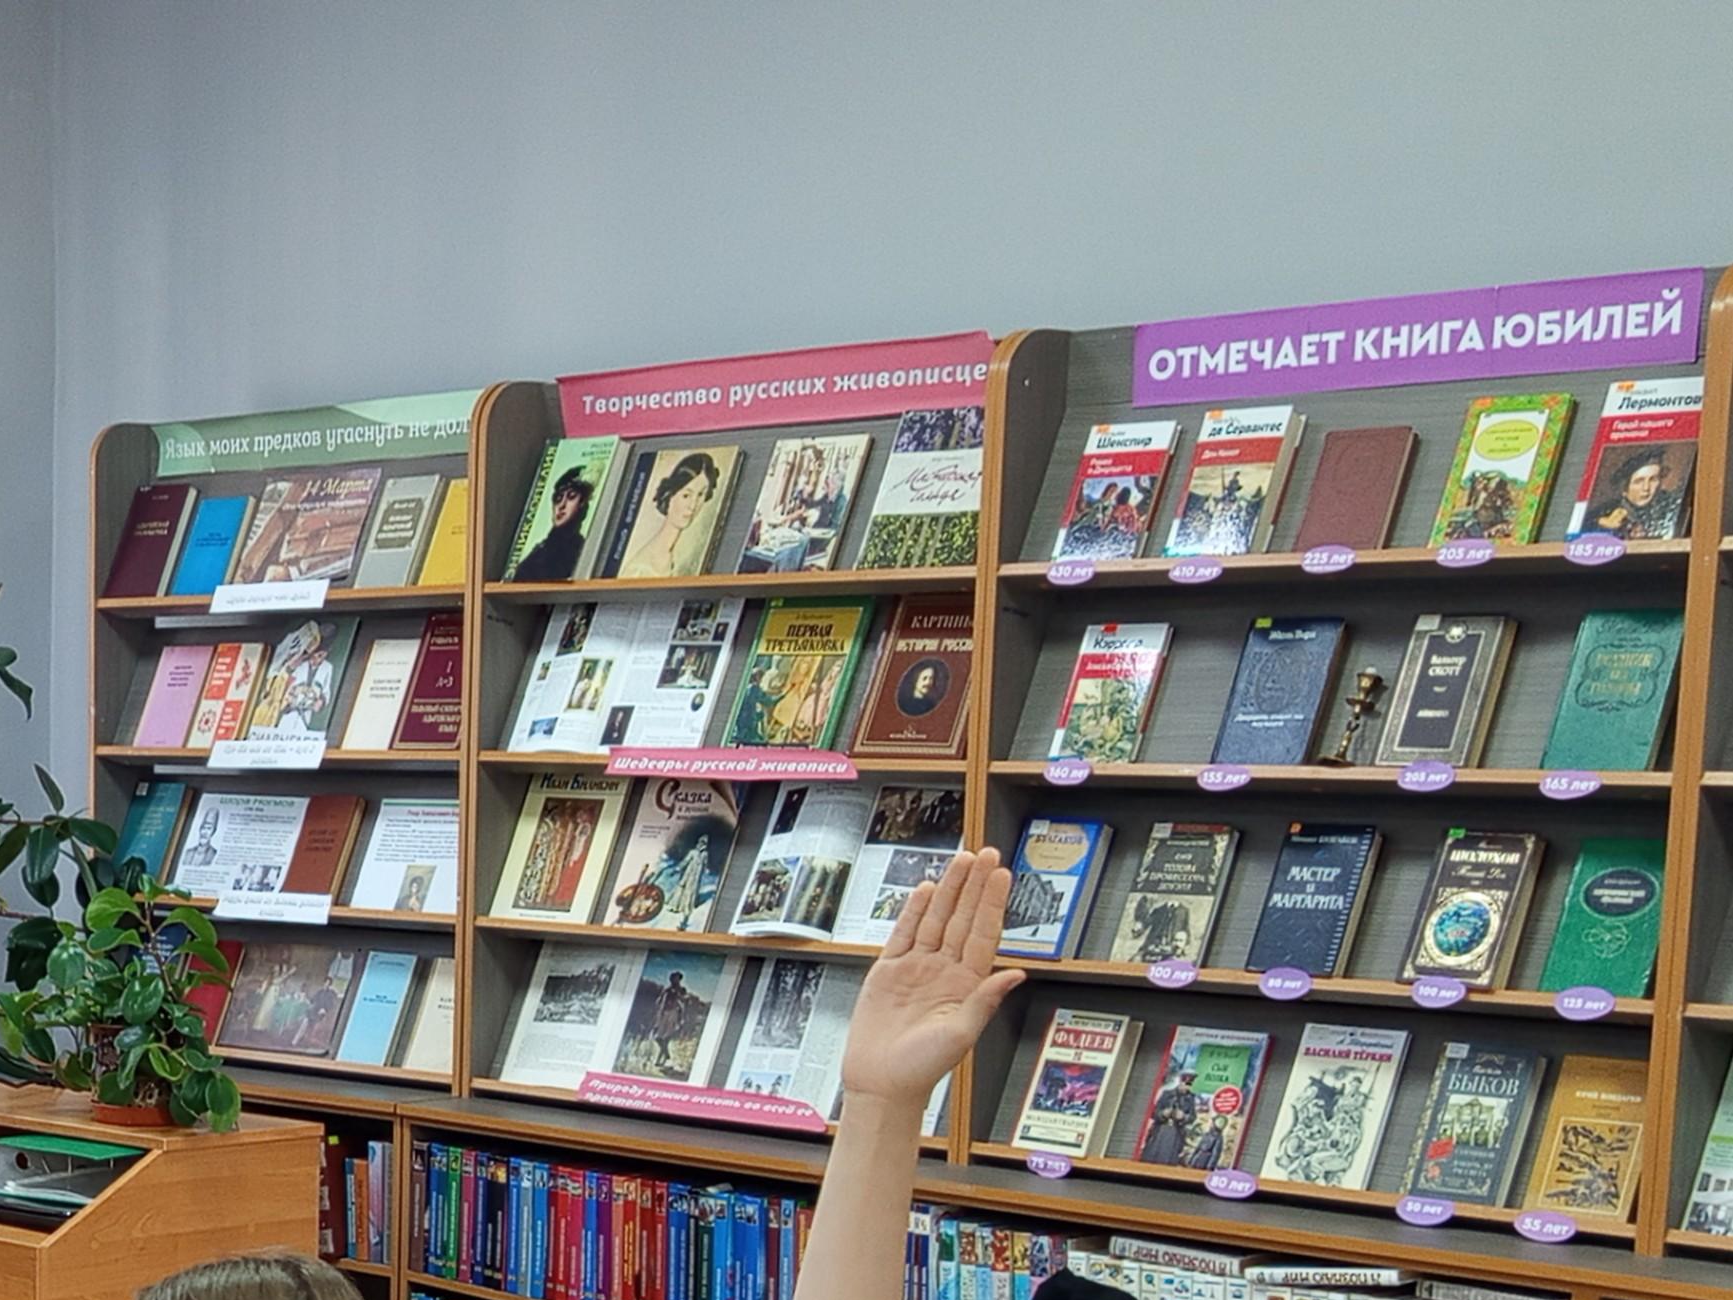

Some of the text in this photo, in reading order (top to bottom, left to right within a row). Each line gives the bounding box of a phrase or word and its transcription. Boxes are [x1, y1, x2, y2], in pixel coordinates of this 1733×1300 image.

[1148, 287, 1684, 383] ОТМЕЧАЕТ КНИГА ЮБИЛЕЙ
[581, 388, 722, 418] Творчество
[727, 374, 826, 407] русских
[1617, 394, 1704, 411] Лермонтов
[1226, 420, 1283, 437] Сервантес
[163, 416, 472, 460] Язык моих предков угаснуть не дол
[1096, 435, 1153, 450] Шекспир
[1438, 548, 1493, 561] 205 лет
[1568, 542, 1623, 558] 185 лет
[1303, 551, 1355, 565] 225 лет
[1071, 567, 1094, 579] лет
[1171, 566, 1221, 578] 410 лет
[786, 623, 835, 638] ПЕРВАЯ
[614, 757, 848, 775] Шедевры русской живописи
[1049, 767, 1088, 779] 160 лет
[1203, 771, 1247, 784] 155 лет
[1426, 772, 1448, 783] лет
[1544, 776, 1599, 793] 165 лет
[1287, 866, 1342, 881] МАСТЕР
[1268, 892, 1344, 911] МАРГАРИТА
[1150, 966, 1193, 981] 100 лет
[1282, 978, 1302, 989] лет
[1418, 985, 1458, 999] 100 лет
[1582, 1000, 1606, 1011] лет
[1054, 1030, 1115, 1050] ФАДЕЕВ
[1448, 1073, 1520, 1098] БЫКОВ
[589, 1079, 646, 1096] Природу
[647, 1087, 690, 1103] нужно
[692, 1093, 742, 1110] искать
[763, 1100, 795, 1116] всей
[1031, 1155, 1067, 1173] 75 лет
[1229, 1178, 1251, 1191] лет
[1422, 1203, 1443, 1216] лет
[1522, 1217, 1569, 1235] 55 лет
[1132, 1245, 1160, 1263] МИР
[1161, 1249, 1219, 1273] ПОЗНАЮ
[1282, 1270, 1311, 1284] МИР
[1312, 1272, 1371, 1285] ПОЗНАЮ
